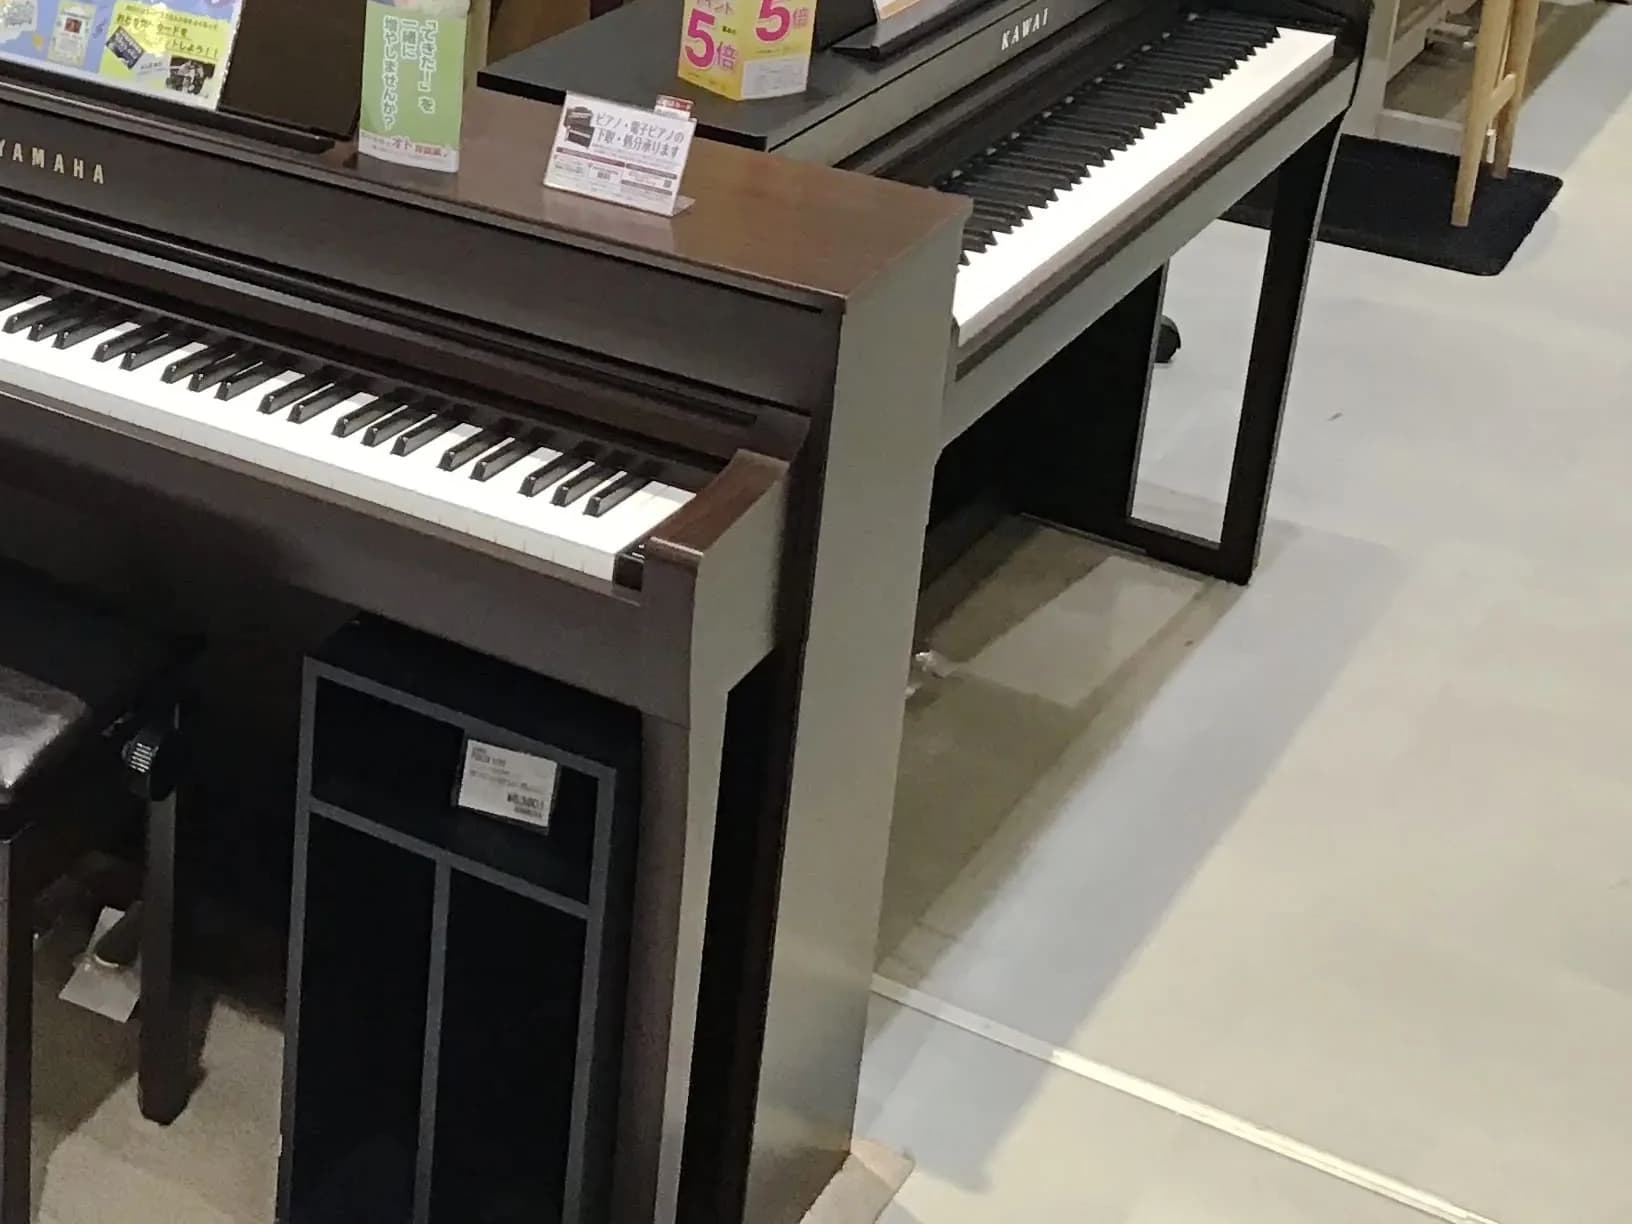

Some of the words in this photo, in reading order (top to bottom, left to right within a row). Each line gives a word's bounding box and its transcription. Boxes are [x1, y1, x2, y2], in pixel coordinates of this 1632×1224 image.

[684, 7, 716, 68] 5
[716, 41, 738, 72] 倍
[1001, 7, 1049, 51] KAWAI
